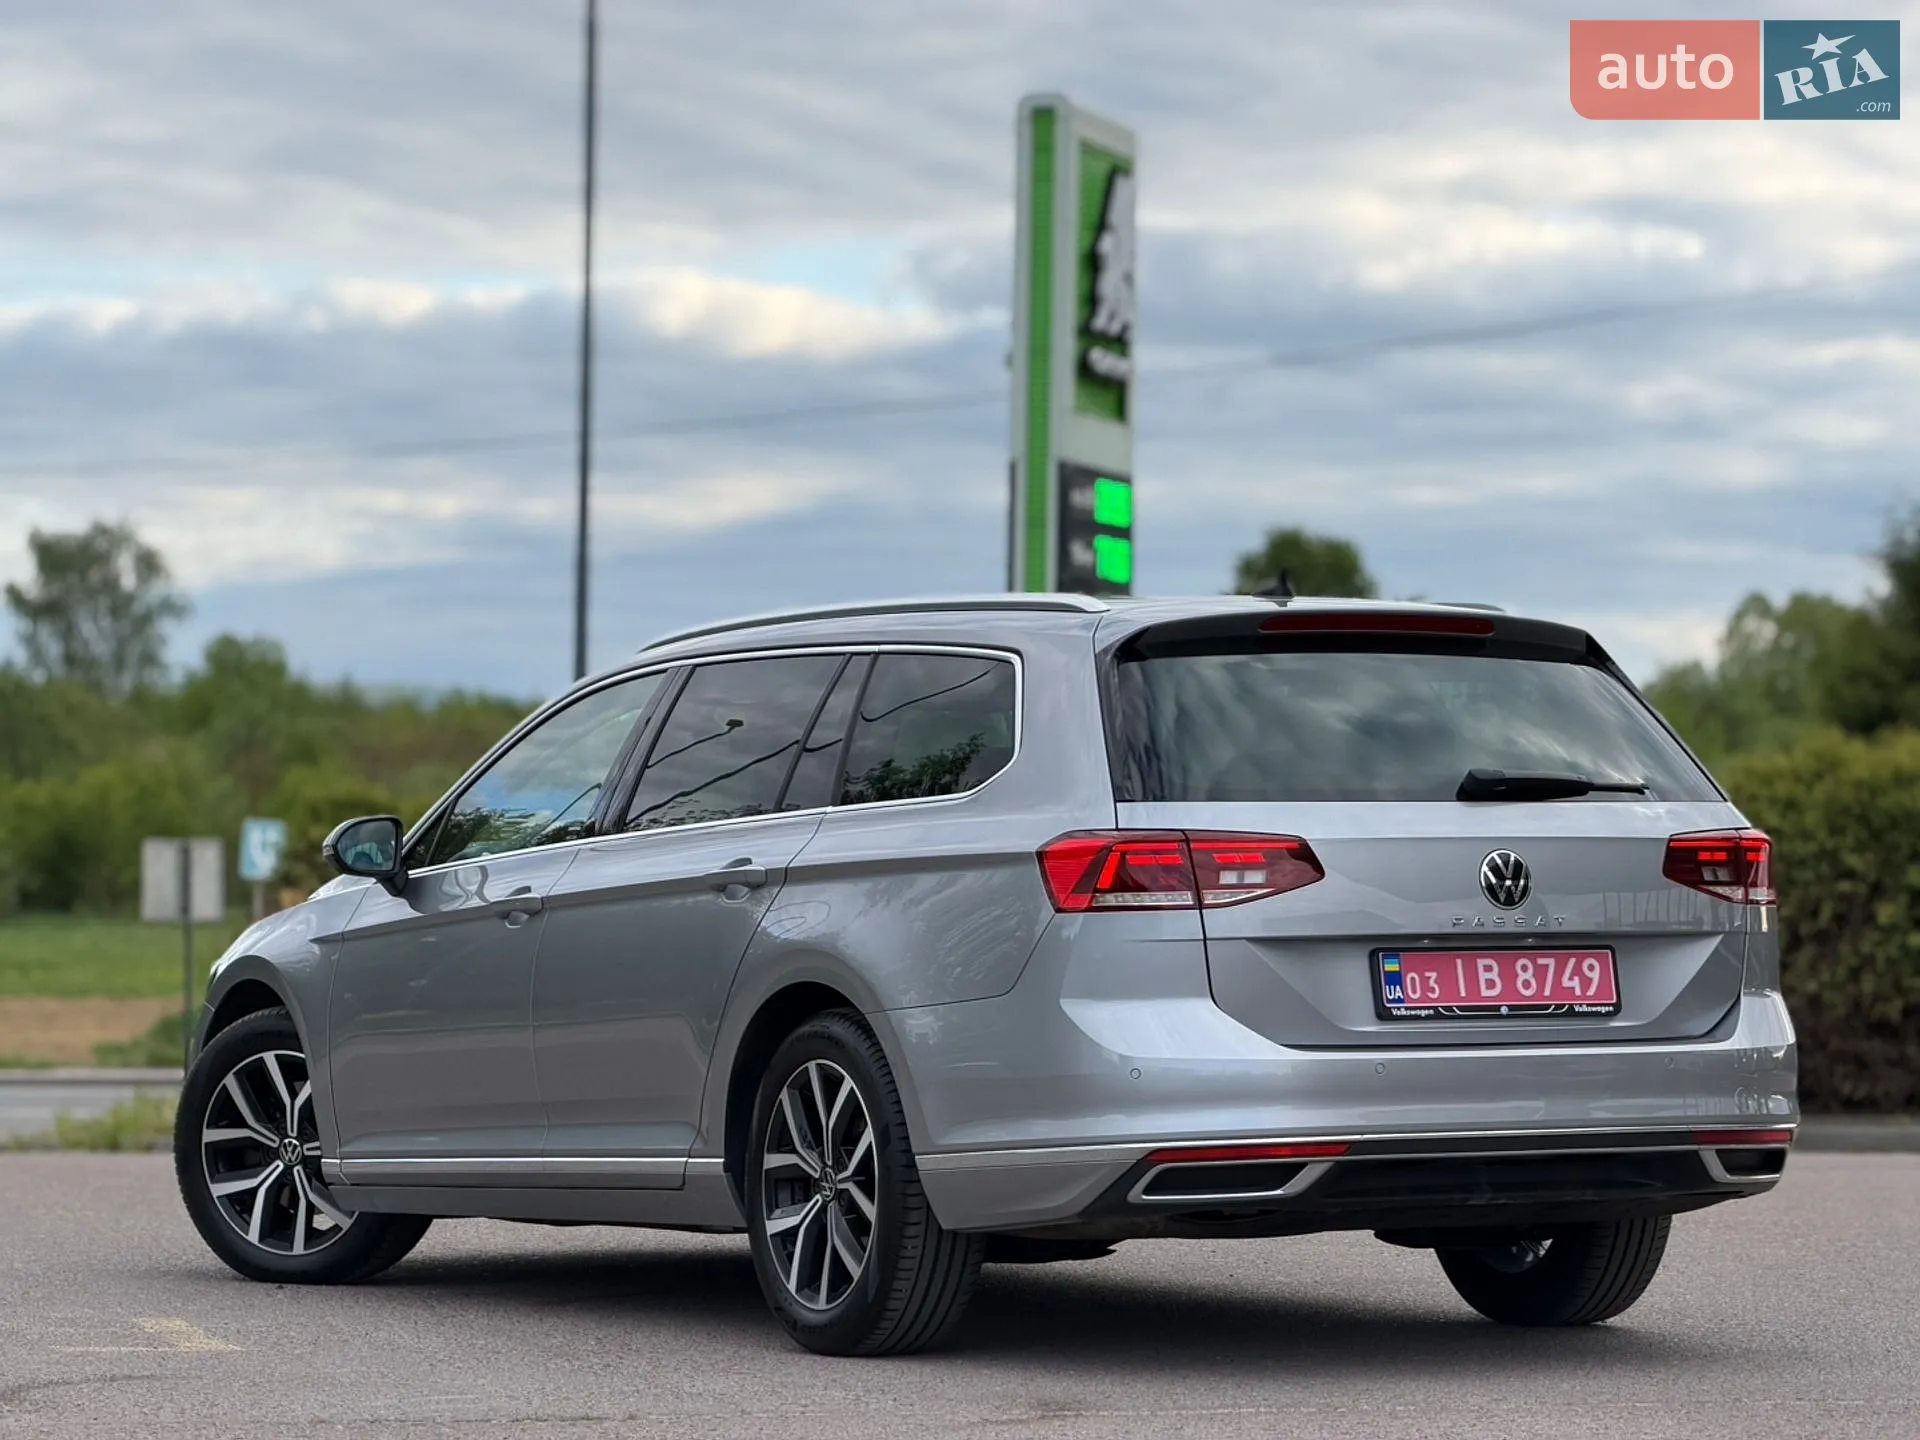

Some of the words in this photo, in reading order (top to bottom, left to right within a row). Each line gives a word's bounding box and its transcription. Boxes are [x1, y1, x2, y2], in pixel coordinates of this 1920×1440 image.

[1451, 915, 1567, 928] PASSAT
[1406, 972, 1440, 999] 03
[1455, 958, 1502, 997] IB
[1514, 957, 1600, 997] 8749
[1385, 985, 1404, 999] UA
[1391, 1007, 1434, 1017] Volkswagen
[1573, 1003, 1614, 1013] Volkswagen
